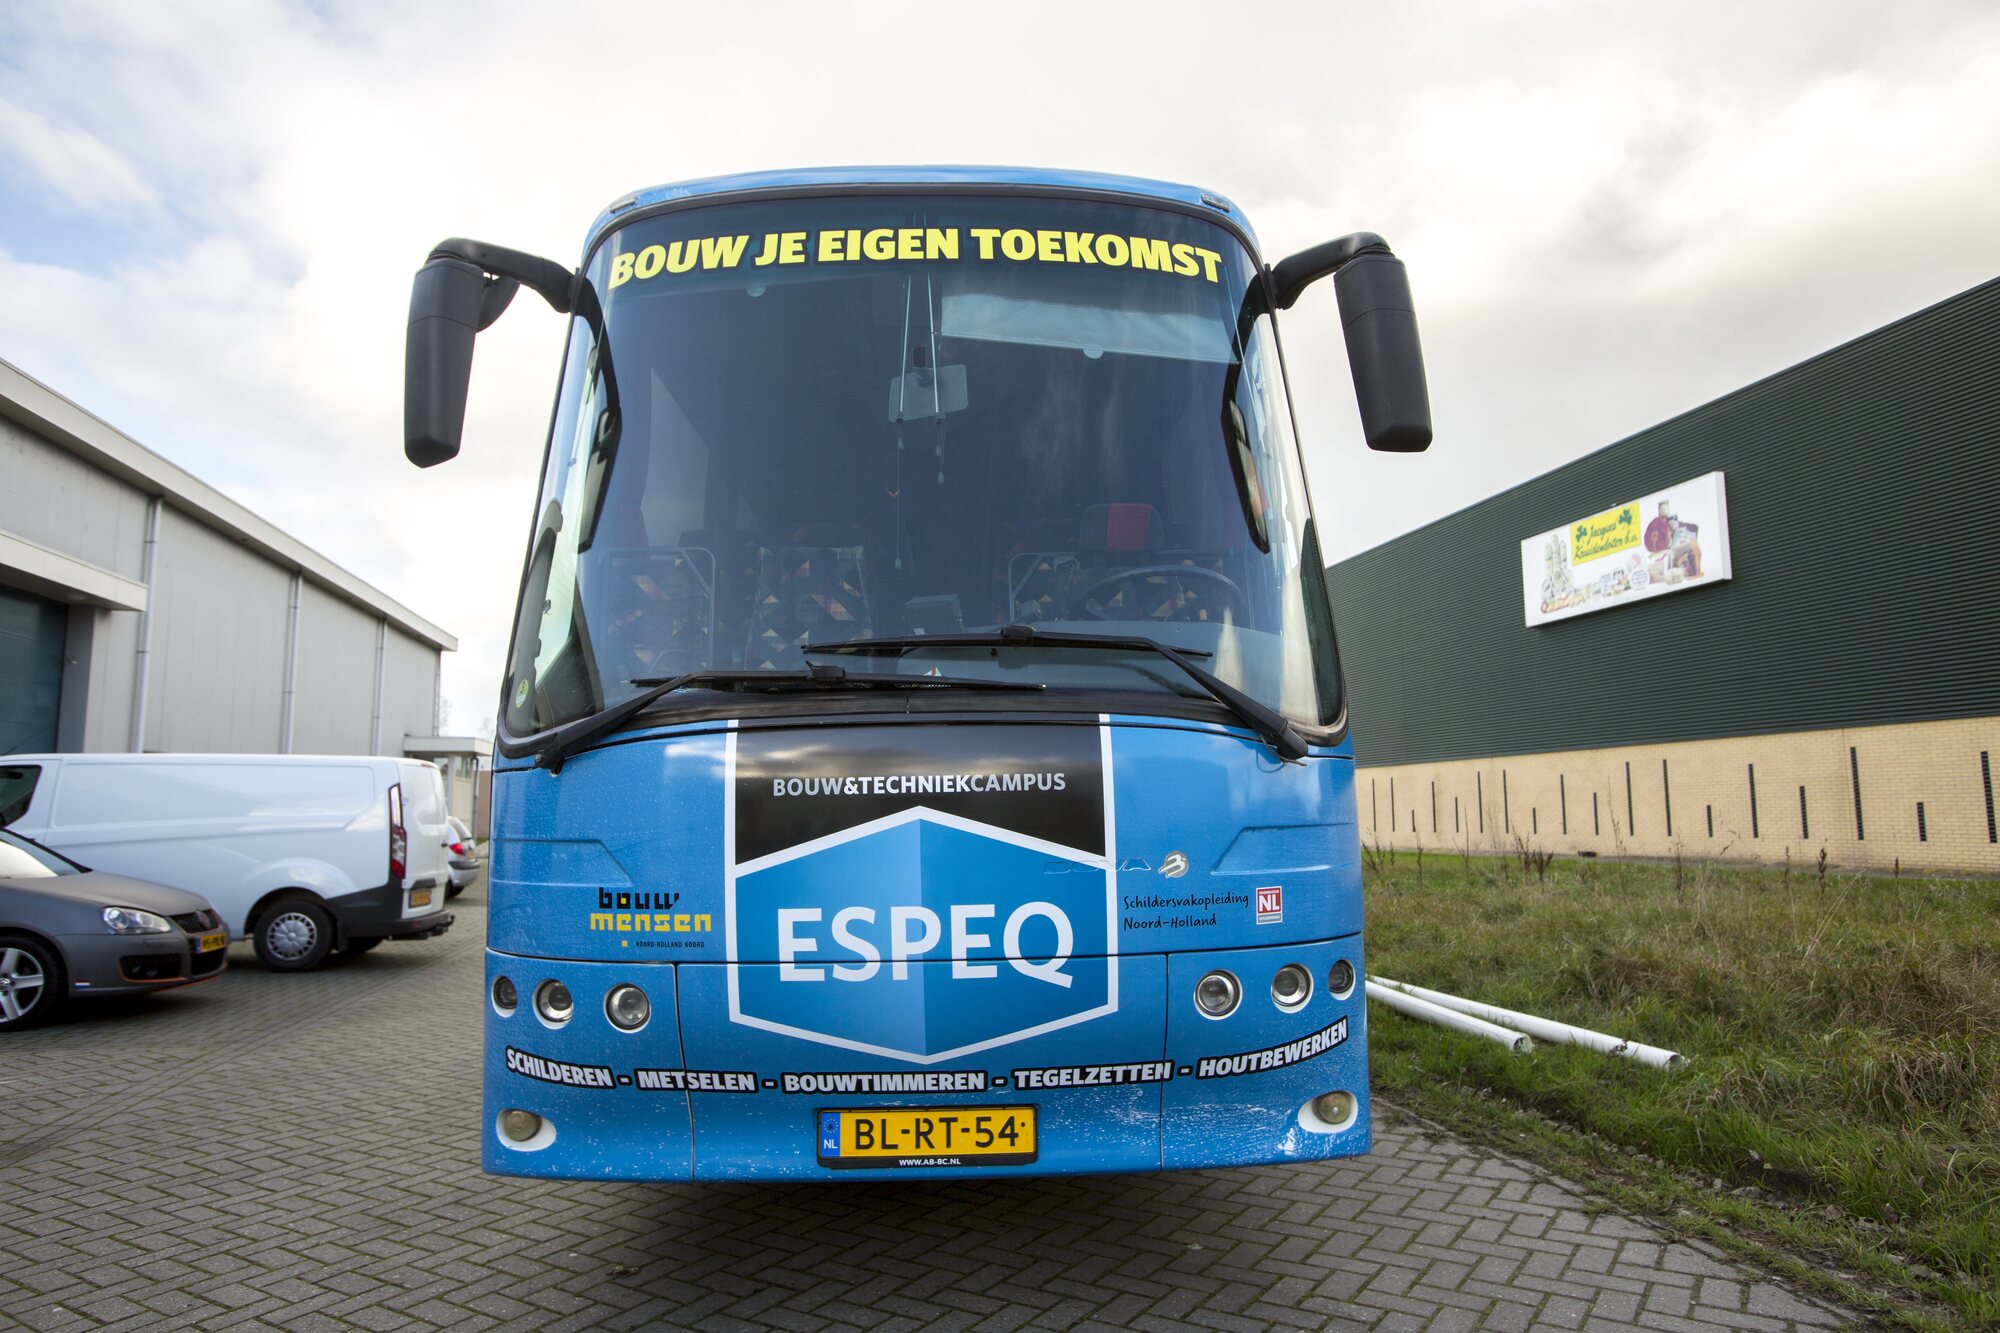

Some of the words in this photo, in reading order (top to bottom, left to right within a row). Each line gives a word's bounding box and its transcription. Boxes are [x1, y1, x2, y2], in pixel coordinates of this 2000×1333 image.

[608, 235, 749, 290] BOUW
[755, 232, 806, 266] JE
[818, 228, 959, 262] EIGEN
[970, 228, 1222, 283] TOEKOMST
[773, 773, 1066, 797] BOUW&TECHNIEKCAMPUS
[598, 887, 680, 909] bouw
[1123, 892, 1249, 910] Schildersvakopleiding
[1258, 894, 1280, 911] NL
[590, 913, 711, 932] mensen
[1123, 913, 1217, 931] Noord-Holland
[778, 901, 1074, 989] ESPEQ
[506, 1049, 614, 1087] SCHILDEREN
[637, 1071, 756, 1091] METSELEN
[783, 1073, 985, 1092] BOUWTIMMEREN
[1015, 1063, 1171, 1088] TEGELZETTEN
[1199, 1019, 1348, 1077] HOUTBEWERKEN
[855, 1115, 1019, 1150] BL-RT-54
[823, 1139, 838, 1149] NL
[899, 1158, 961, 1166] WWW.AB-BC.NL
